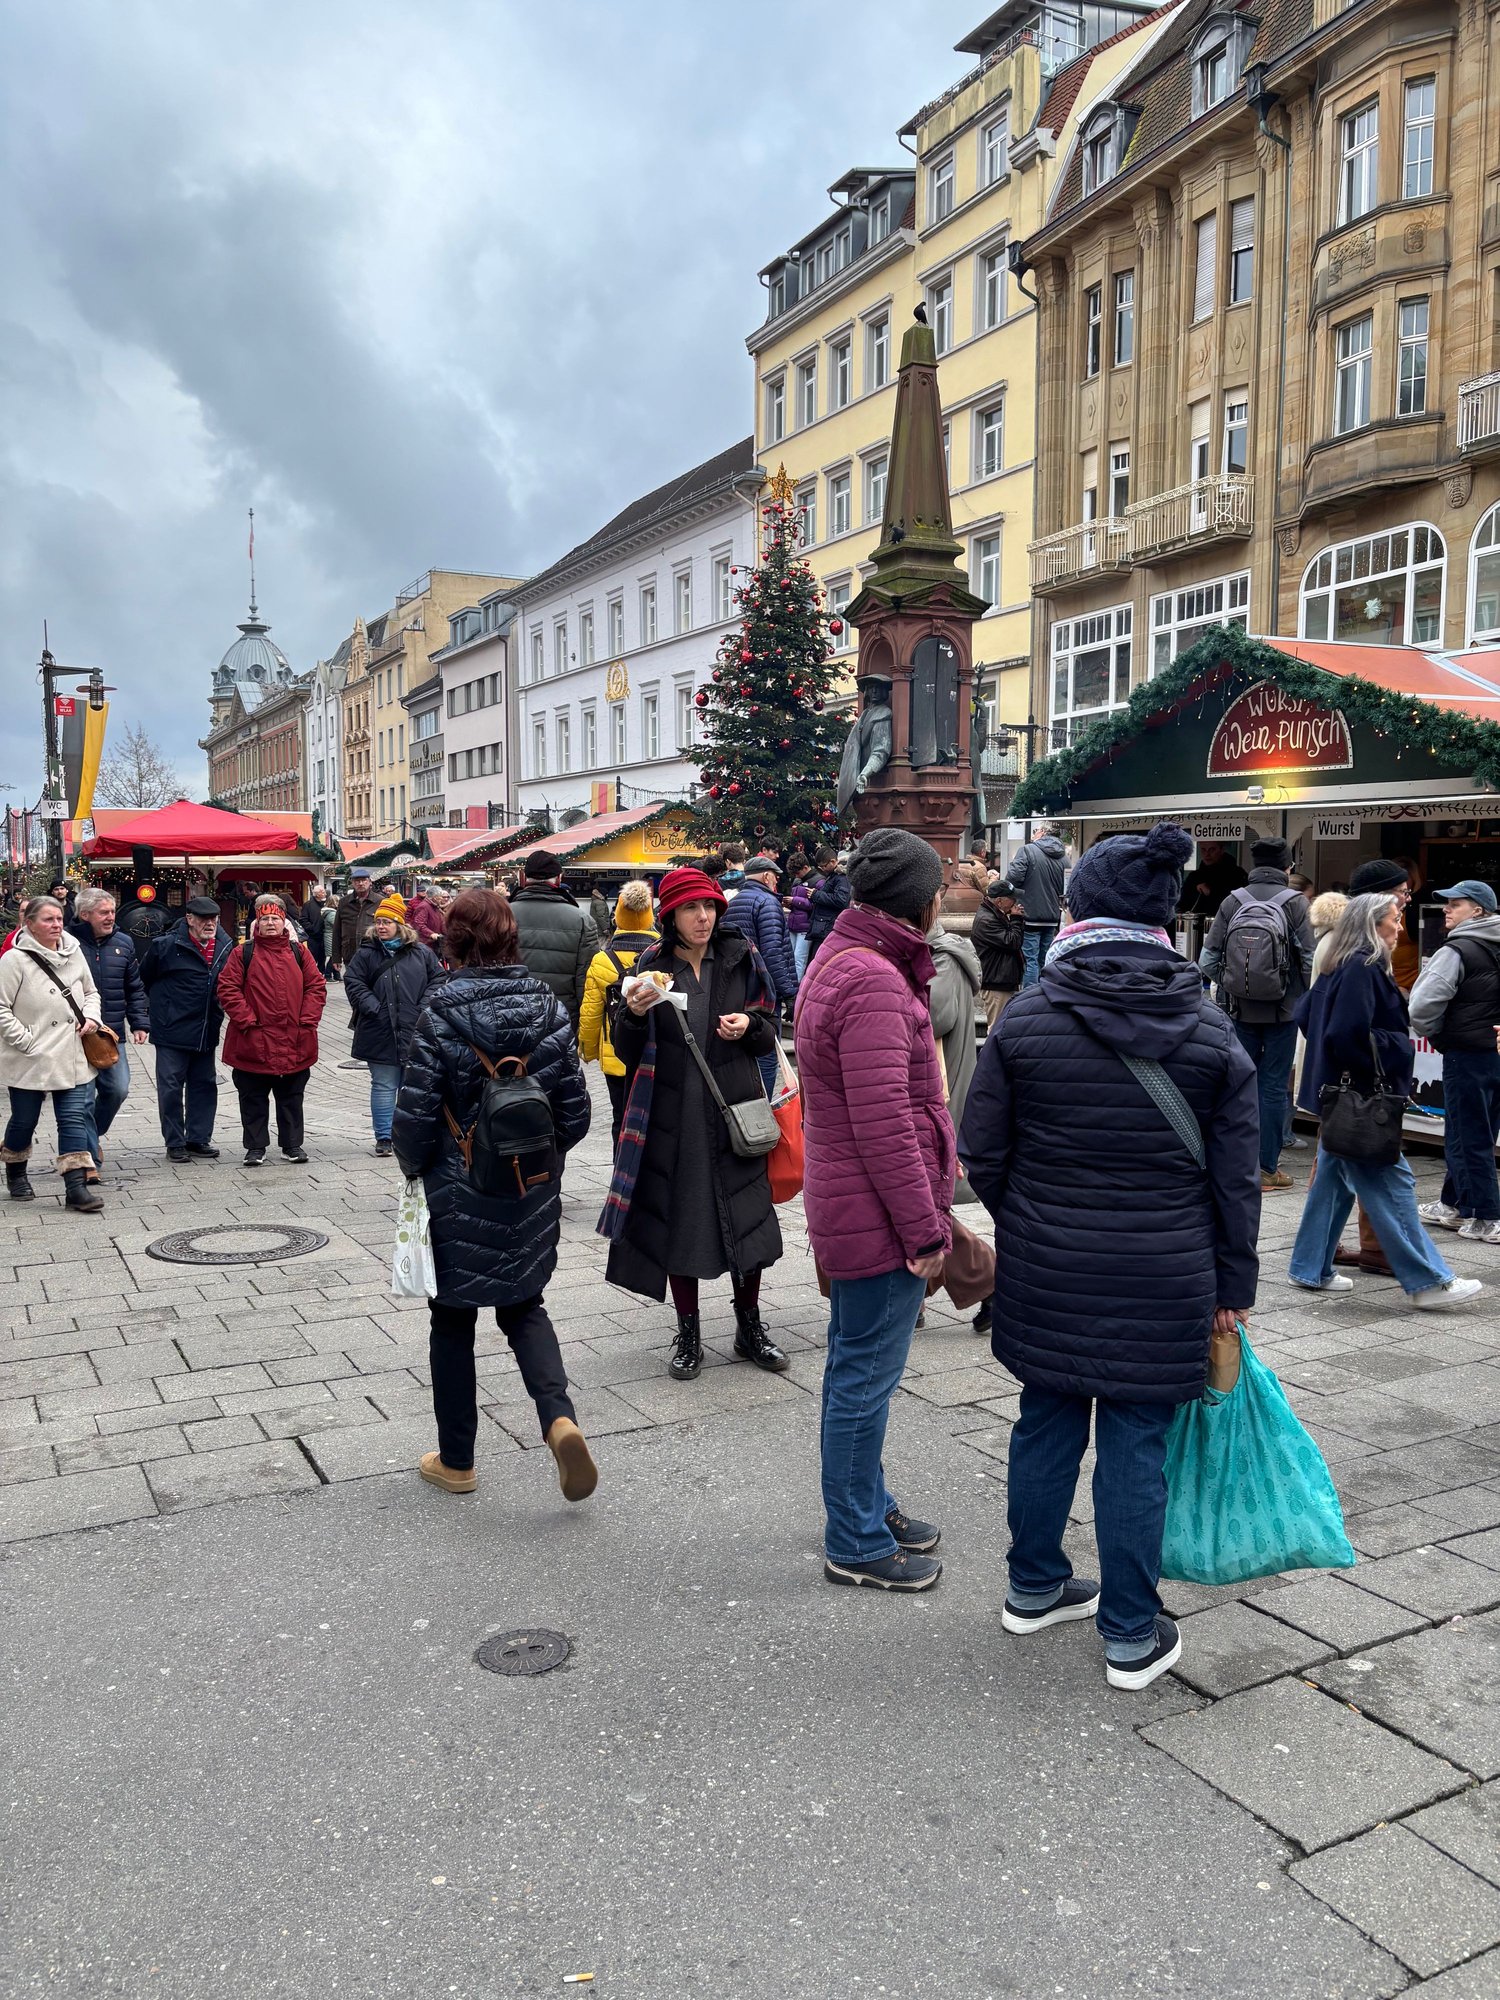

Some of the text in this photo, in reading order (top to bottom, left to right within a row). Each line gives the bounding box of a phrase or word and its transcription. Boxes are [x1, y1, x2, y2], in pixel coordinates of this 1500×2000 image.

[1220, 722, 1276, 761] Wein,
[47, 801, 62, 810] WC
[1194, 822, 1242, 838] Getränke
[1318, 820, 1355, 836] Wurst
